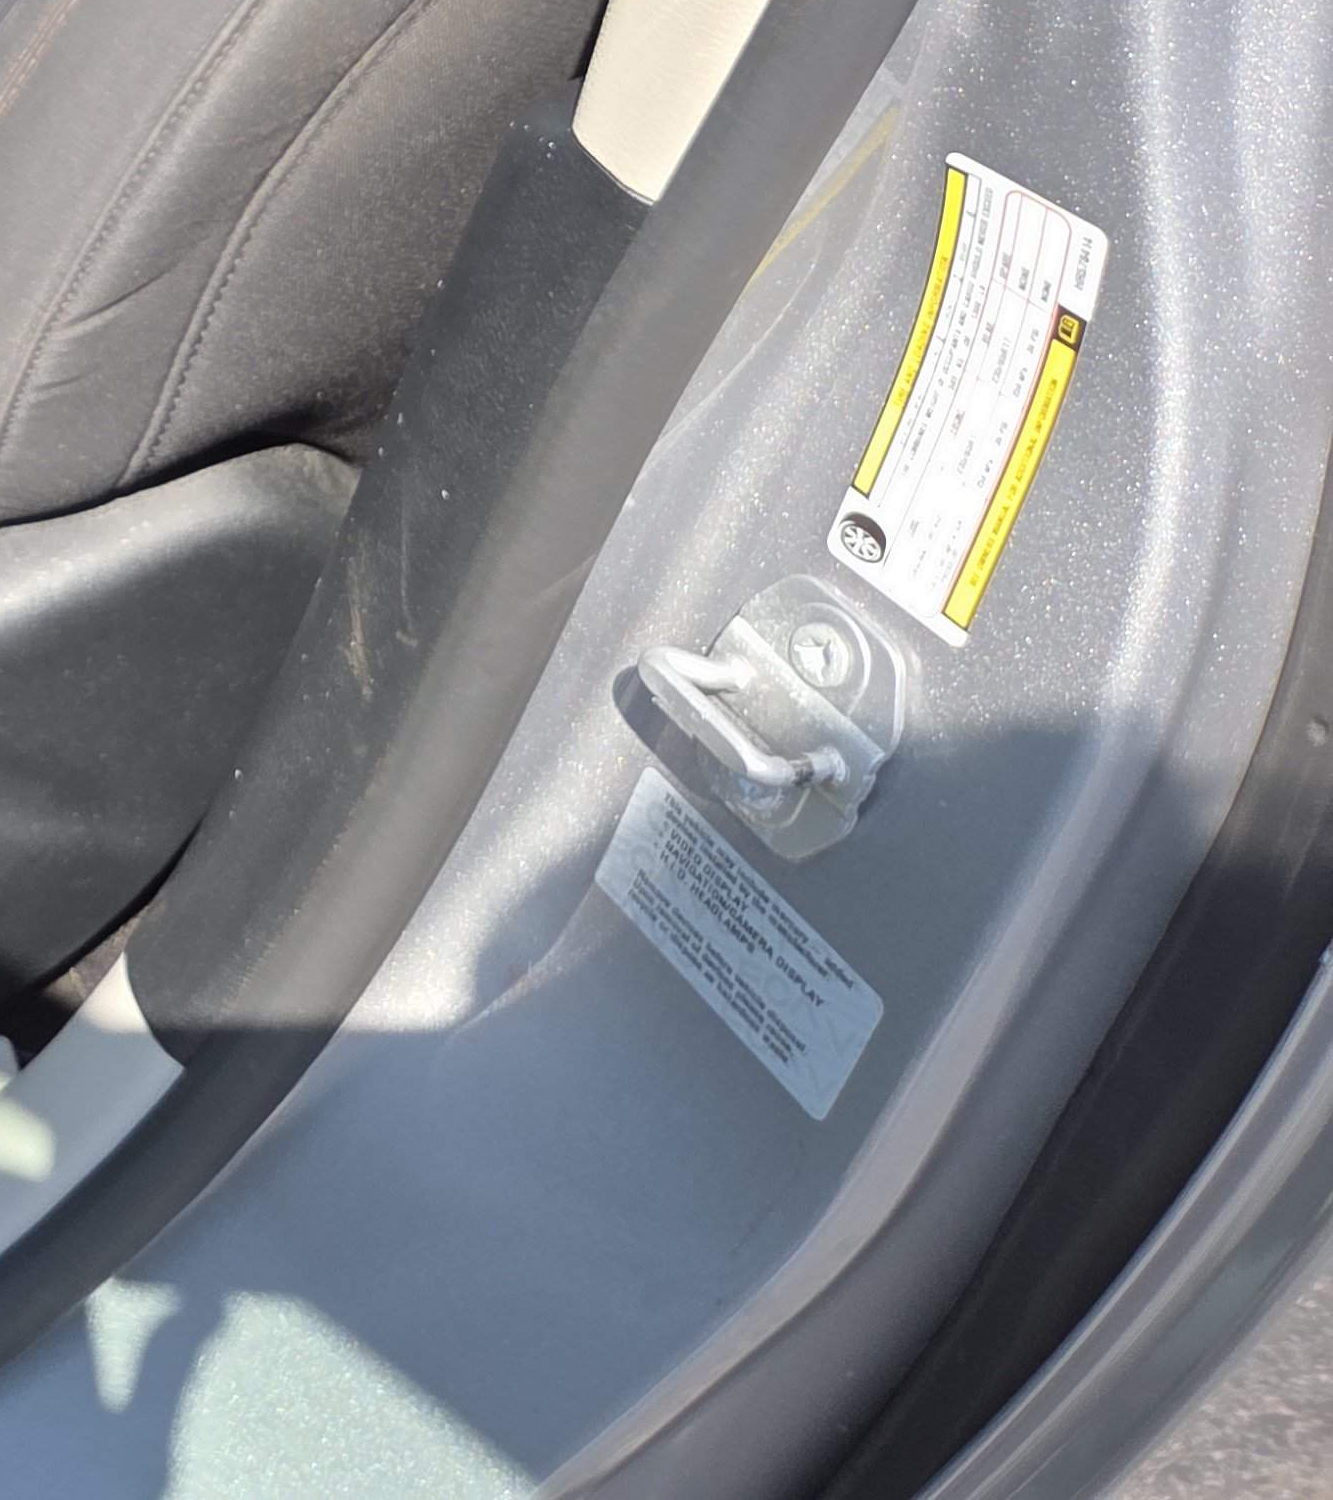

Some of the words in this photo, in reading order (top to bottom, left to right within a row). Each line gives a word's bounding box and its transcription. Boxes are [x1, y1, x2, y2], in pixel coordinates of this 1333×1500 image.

[1015, 265, 1031, 291] NONE
[682, 811, 715, 848] vehicle
[669, 828, 703, 867] VIDEO
[702, 862, 749, 914] DISPLAY
[663, 839, 775, 959] NAVIGATION/CAMERA
[774, 953, 825, 1010] DISPLAY
[689, 881, 756, 955] HEADLAMPS
